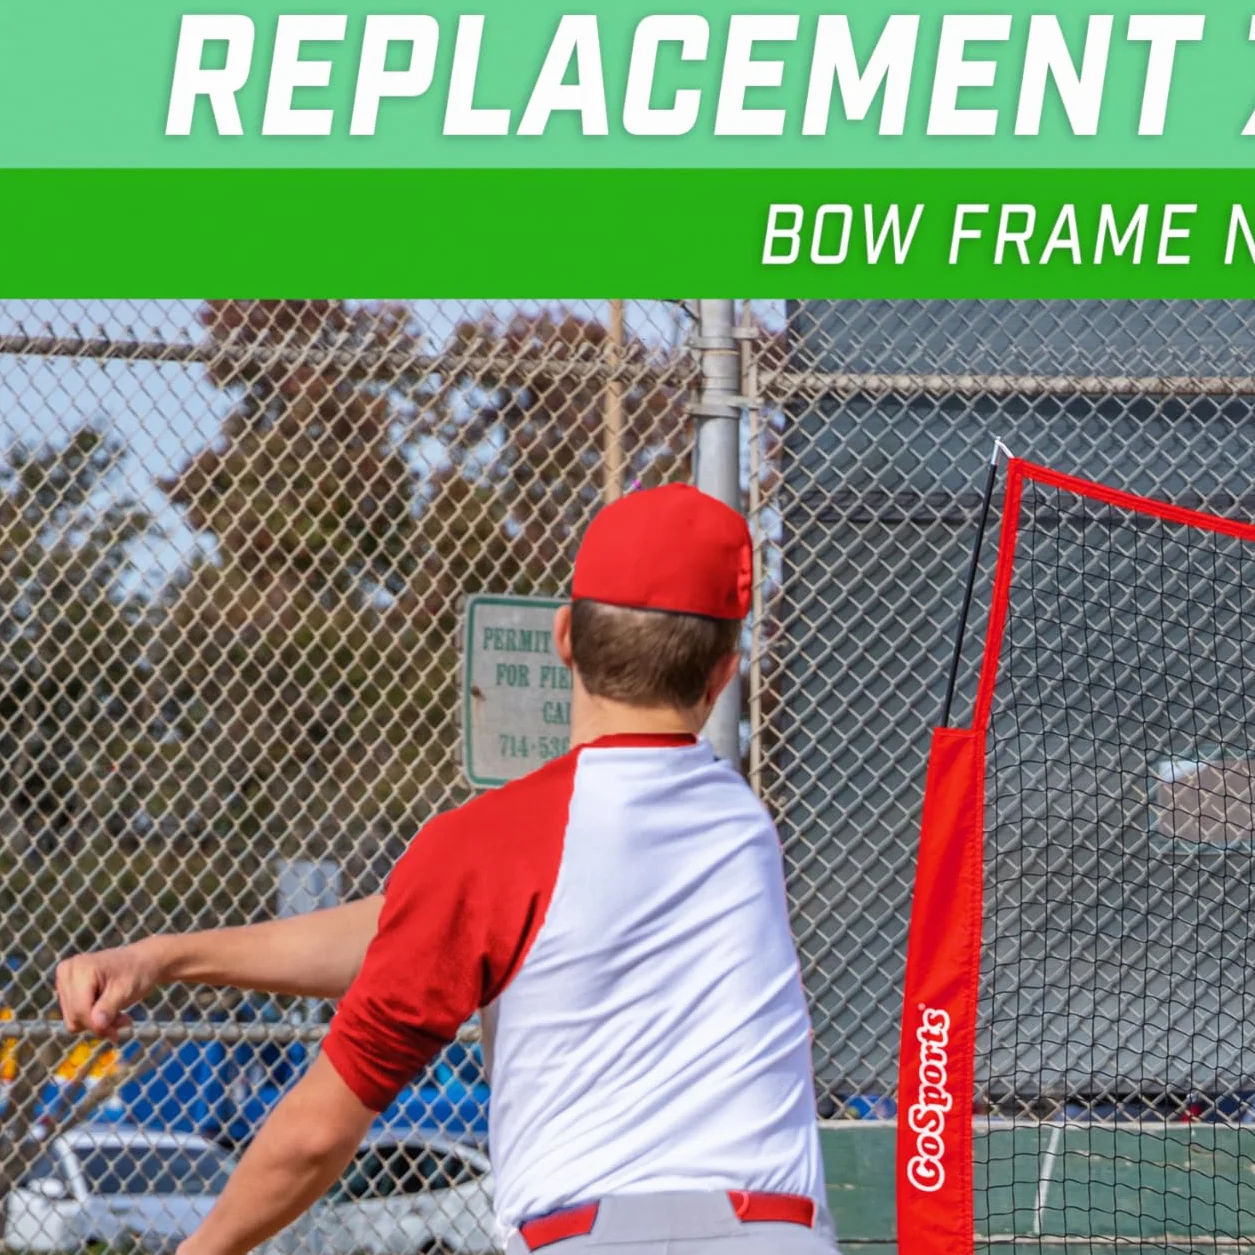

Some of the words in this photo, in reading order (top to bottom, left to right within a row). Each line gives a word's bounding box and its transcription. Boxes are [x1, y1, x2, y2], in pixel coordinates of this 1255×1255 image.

[482, 626, 552, 653] PERMIT
[496, 663, 530, 688] FOR
[540, 666, 573, 689] FIE
[907, 1007, 953, 1192] GoSports
